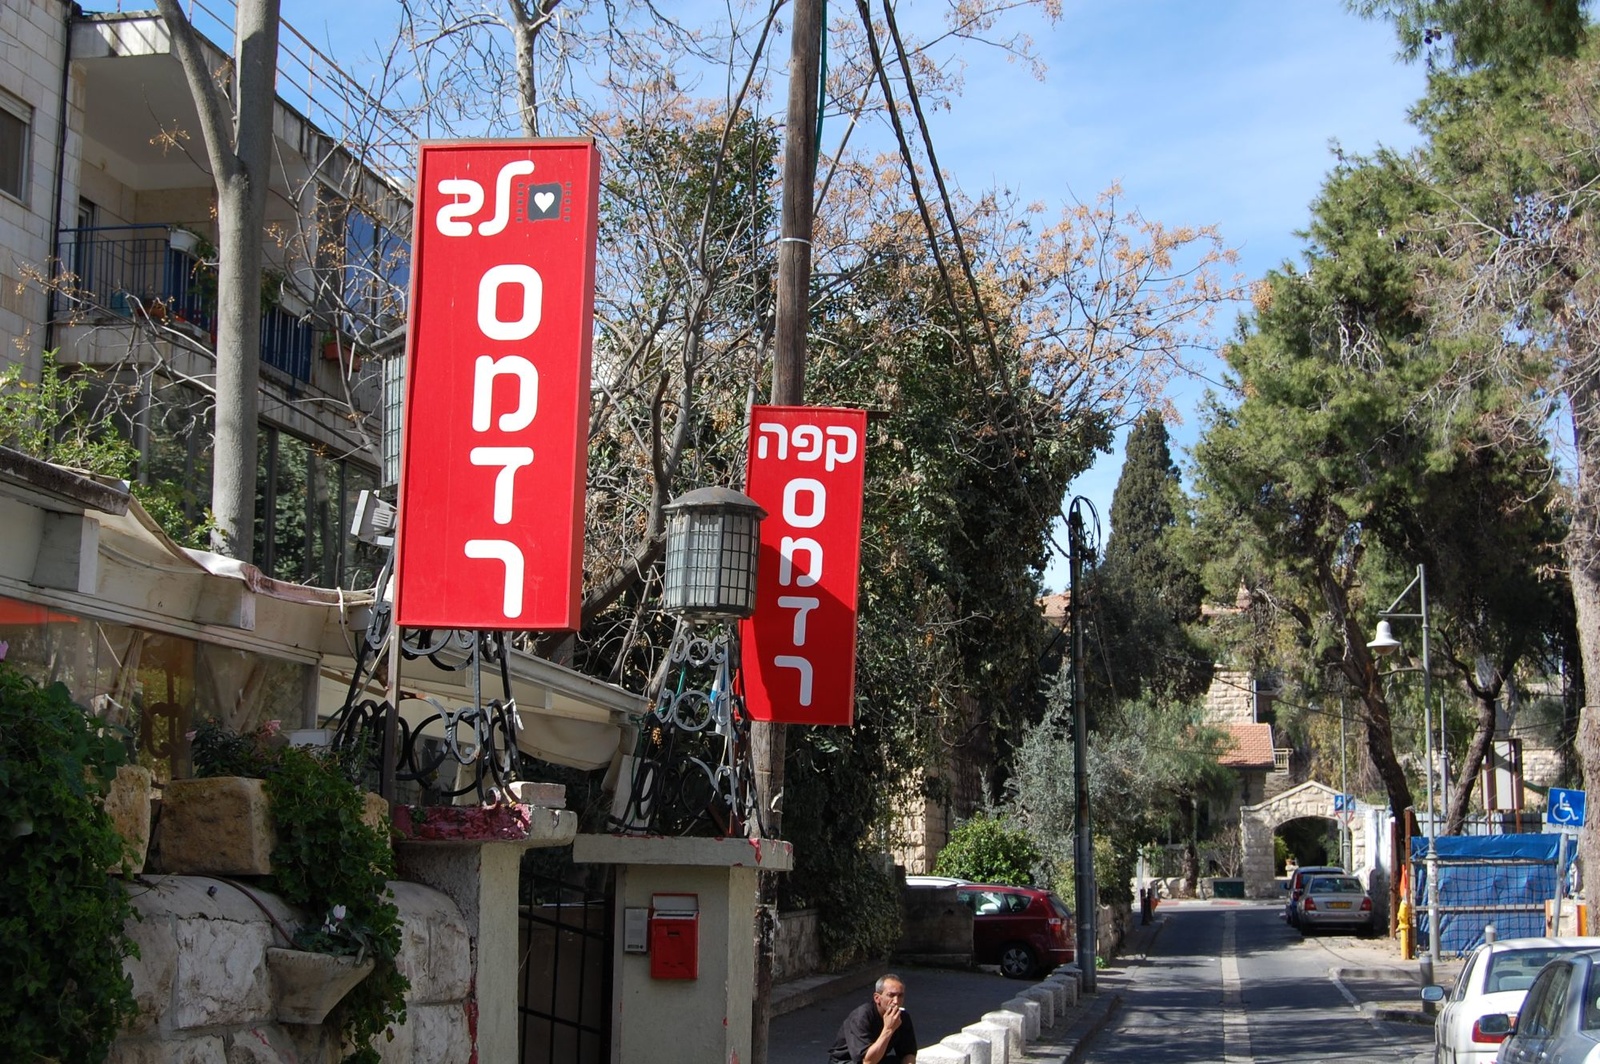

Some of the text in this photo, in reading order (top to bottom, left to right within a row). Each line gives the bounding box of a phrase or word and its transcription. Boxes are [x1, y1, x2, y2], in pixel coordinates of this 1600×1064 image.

[464, 264, 543, 618] סמדר
[758, 423, 858, 472] קפה
[774, 477, 827, 706] סמדר
